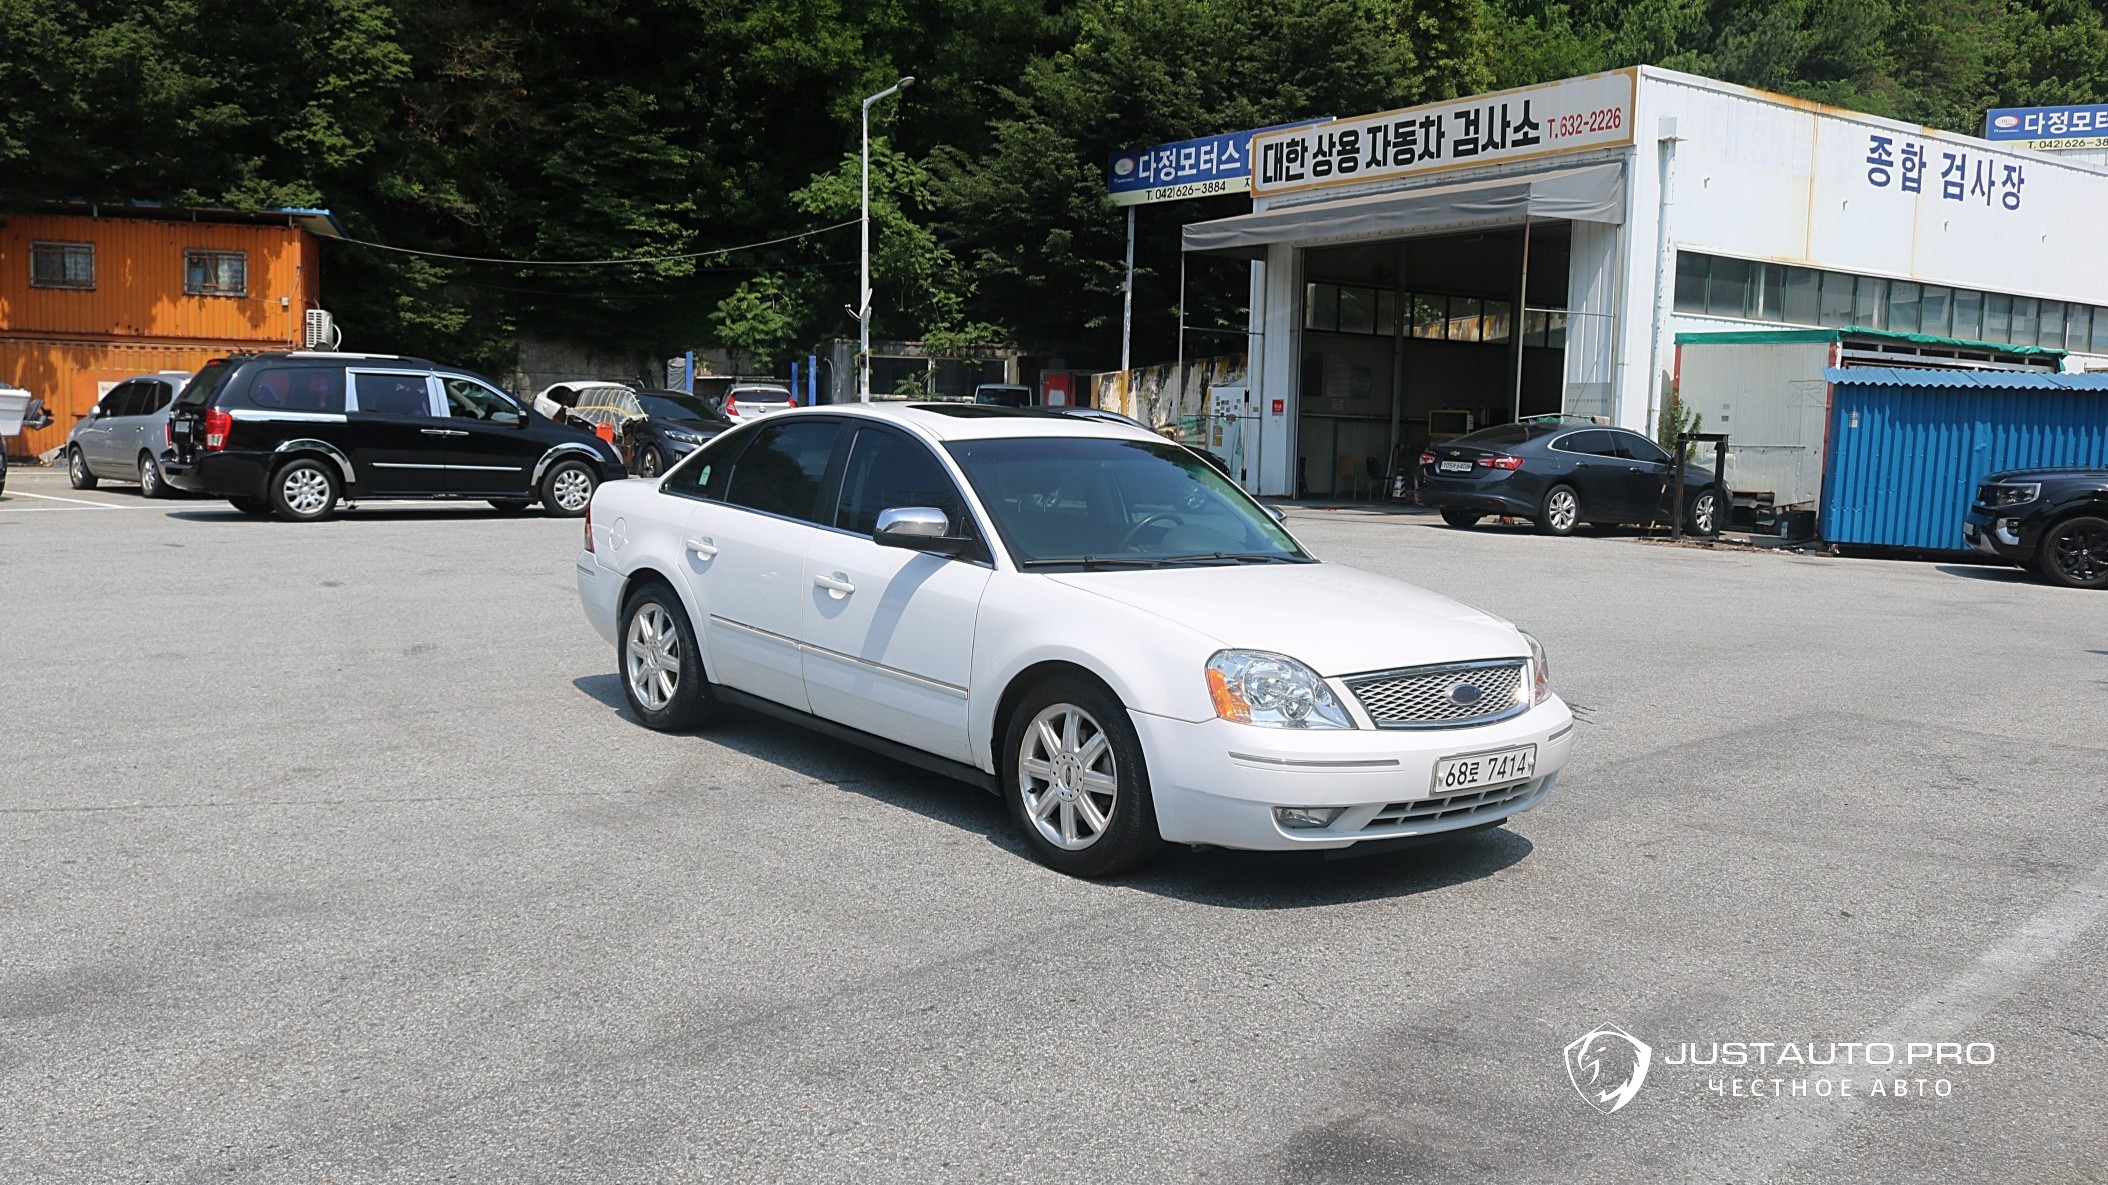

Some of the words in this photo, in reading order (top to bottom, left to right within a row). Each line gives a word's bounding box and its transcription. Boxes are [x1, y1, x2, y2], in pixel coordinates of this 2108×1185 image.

[1138, 140, 1241, 183] 다정모터스
[1262, 138, 1308, 184] 대한
[1312, 130, 1360, 177] 상용
[1366, 114, 1446, 169] 자동차
[1452, 100, 1541, 158] 검사소
[1866, 134, 1927, 194] 종합
[1940, 152, 2025, 211] 검사장
[1445, 761, 1480, 787] 68로
[1487, 752, 1527, 781] 7414
